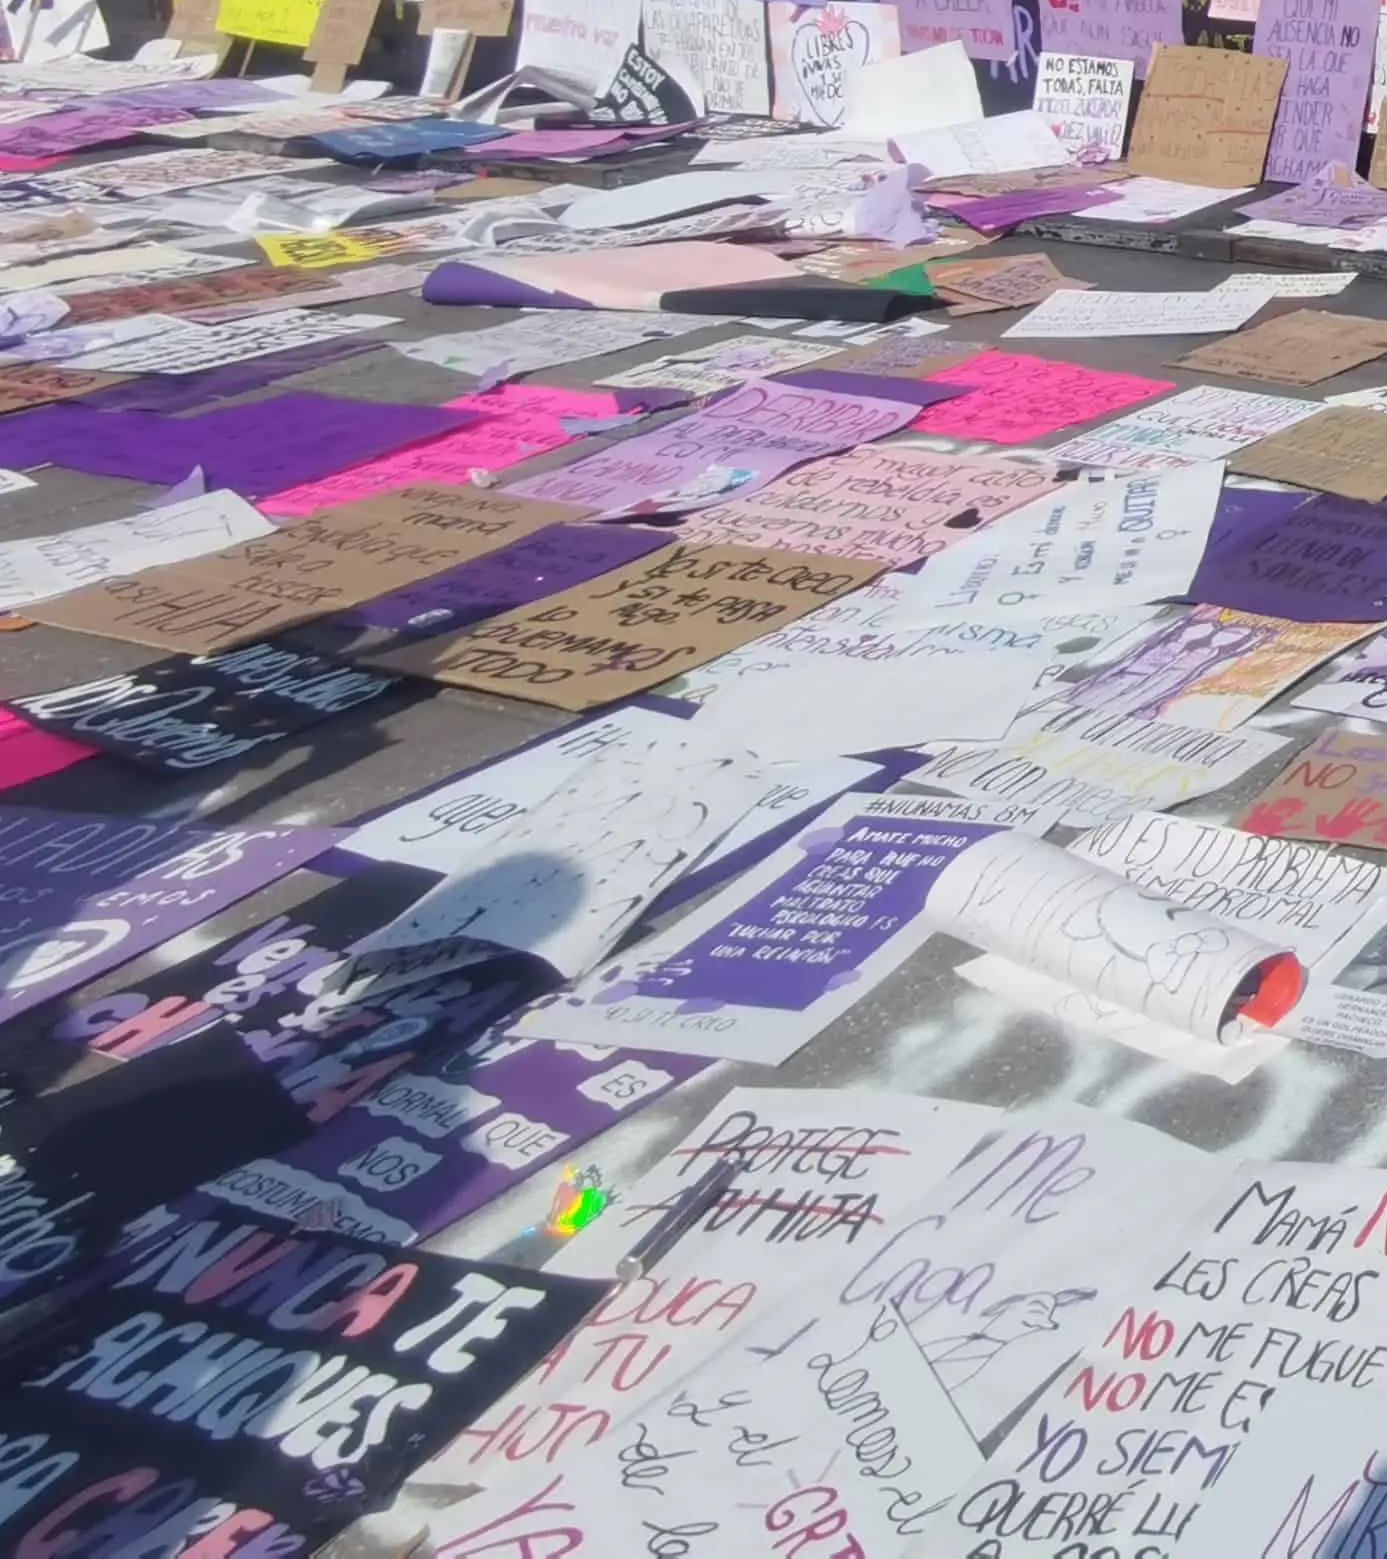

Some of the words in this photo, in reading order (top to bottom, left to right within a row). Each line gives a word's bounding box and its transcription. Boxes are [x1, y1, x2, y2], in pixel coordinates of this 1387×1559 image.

[1046, 57, 1063, 71] NO
[1069, 59, 1119, 76] ESTAMOS
[1088, 79, 1123, 96] FALTA
[447, 649, 575, 687] TODO
[600, 1072, 645, 1100] ES
[486, 1116, 555, 1160] QUE
[355, 1143, 422, 1187] NOS
[1155, 1253, 1230, 1302] LES
[1242, 1257, 1378, 1318] CREAS
[394, 1273, 547, 1375] TE
[1103, 1308, 1175, 1362] NO
[1186, 1320, 1258, 1360] ME
